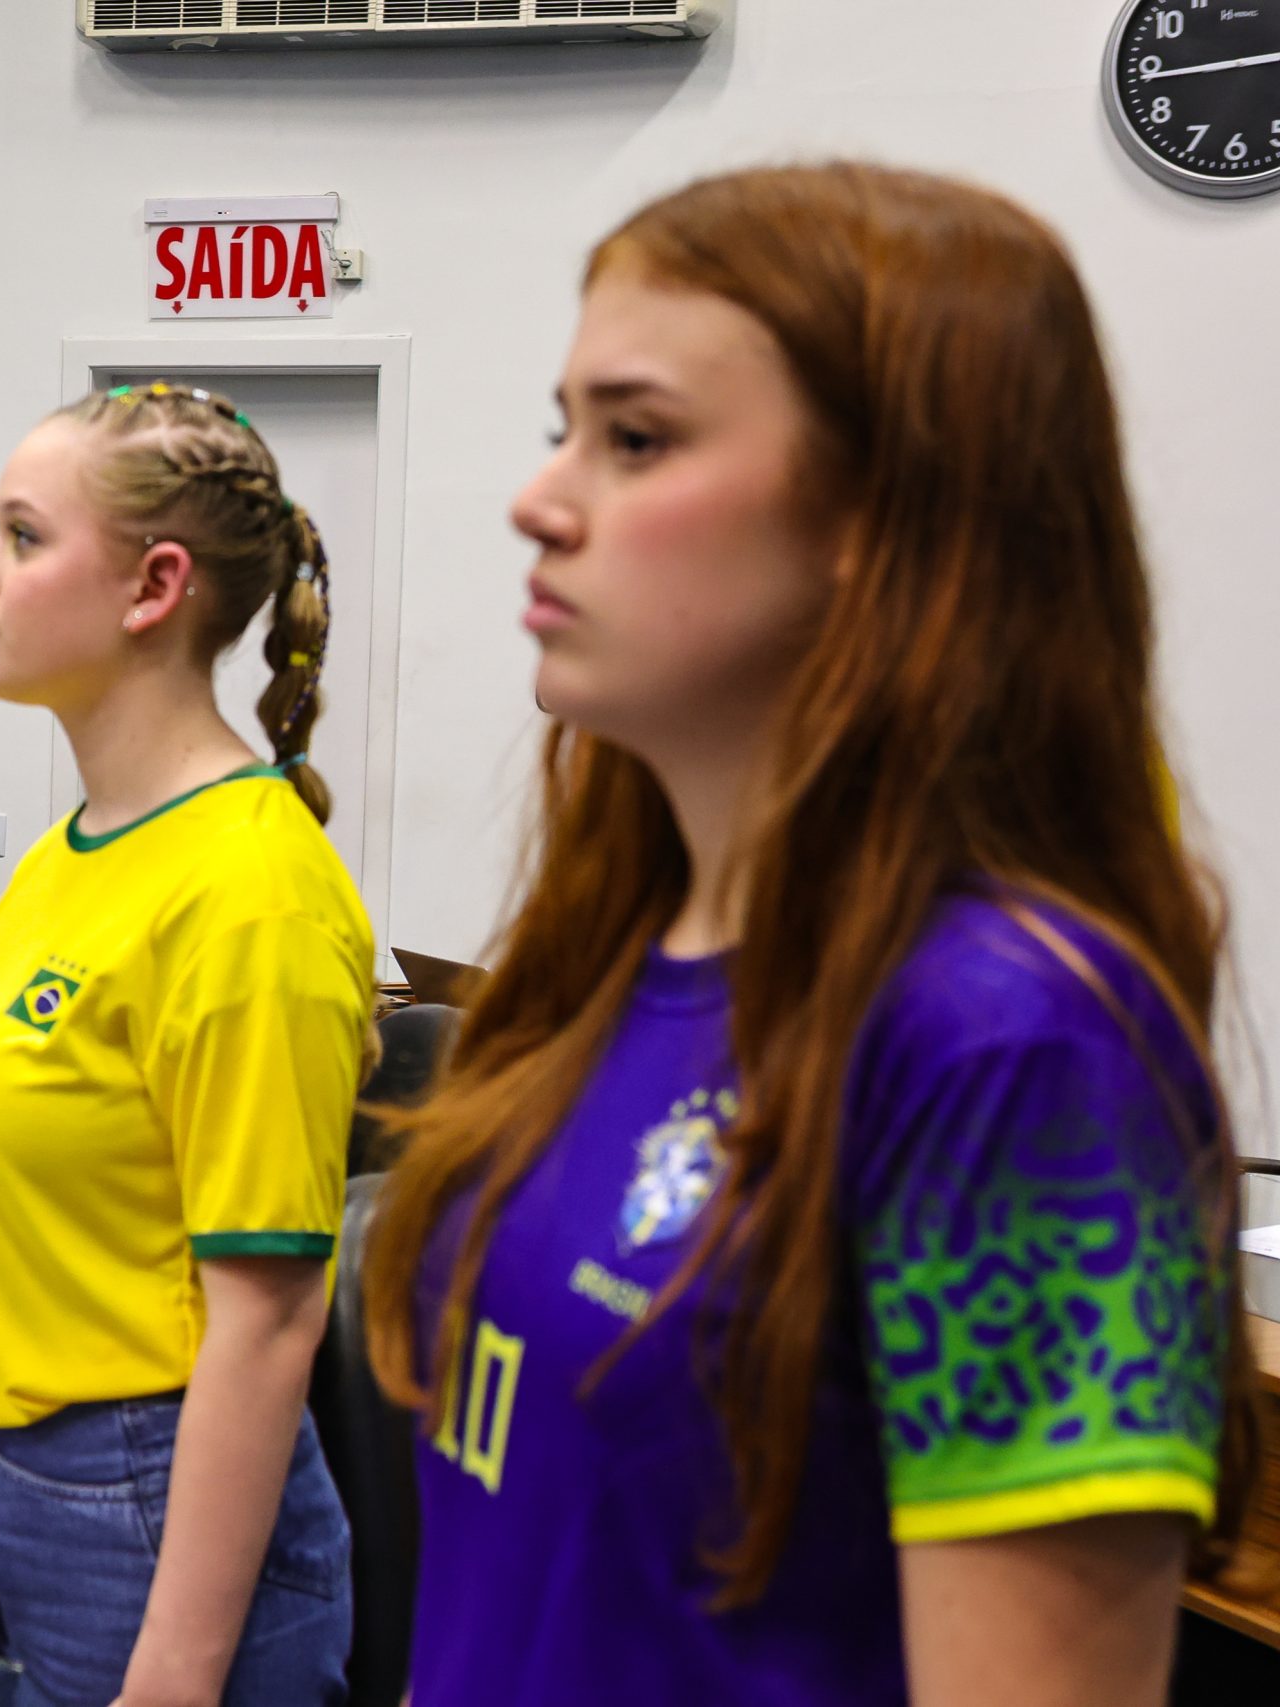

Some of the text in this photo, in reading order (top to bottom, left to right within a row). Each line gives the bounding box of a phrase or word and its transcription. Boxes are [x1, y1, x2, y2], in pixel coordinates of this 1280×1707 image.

[1156, 10, 1184, 39] 10
[1139, 55, 1162, 83] 9
[1150, 96, 1172, 124] 8
[1185, 124, 1211, 153] 7
[1224, 132, 1248, 161] 6
